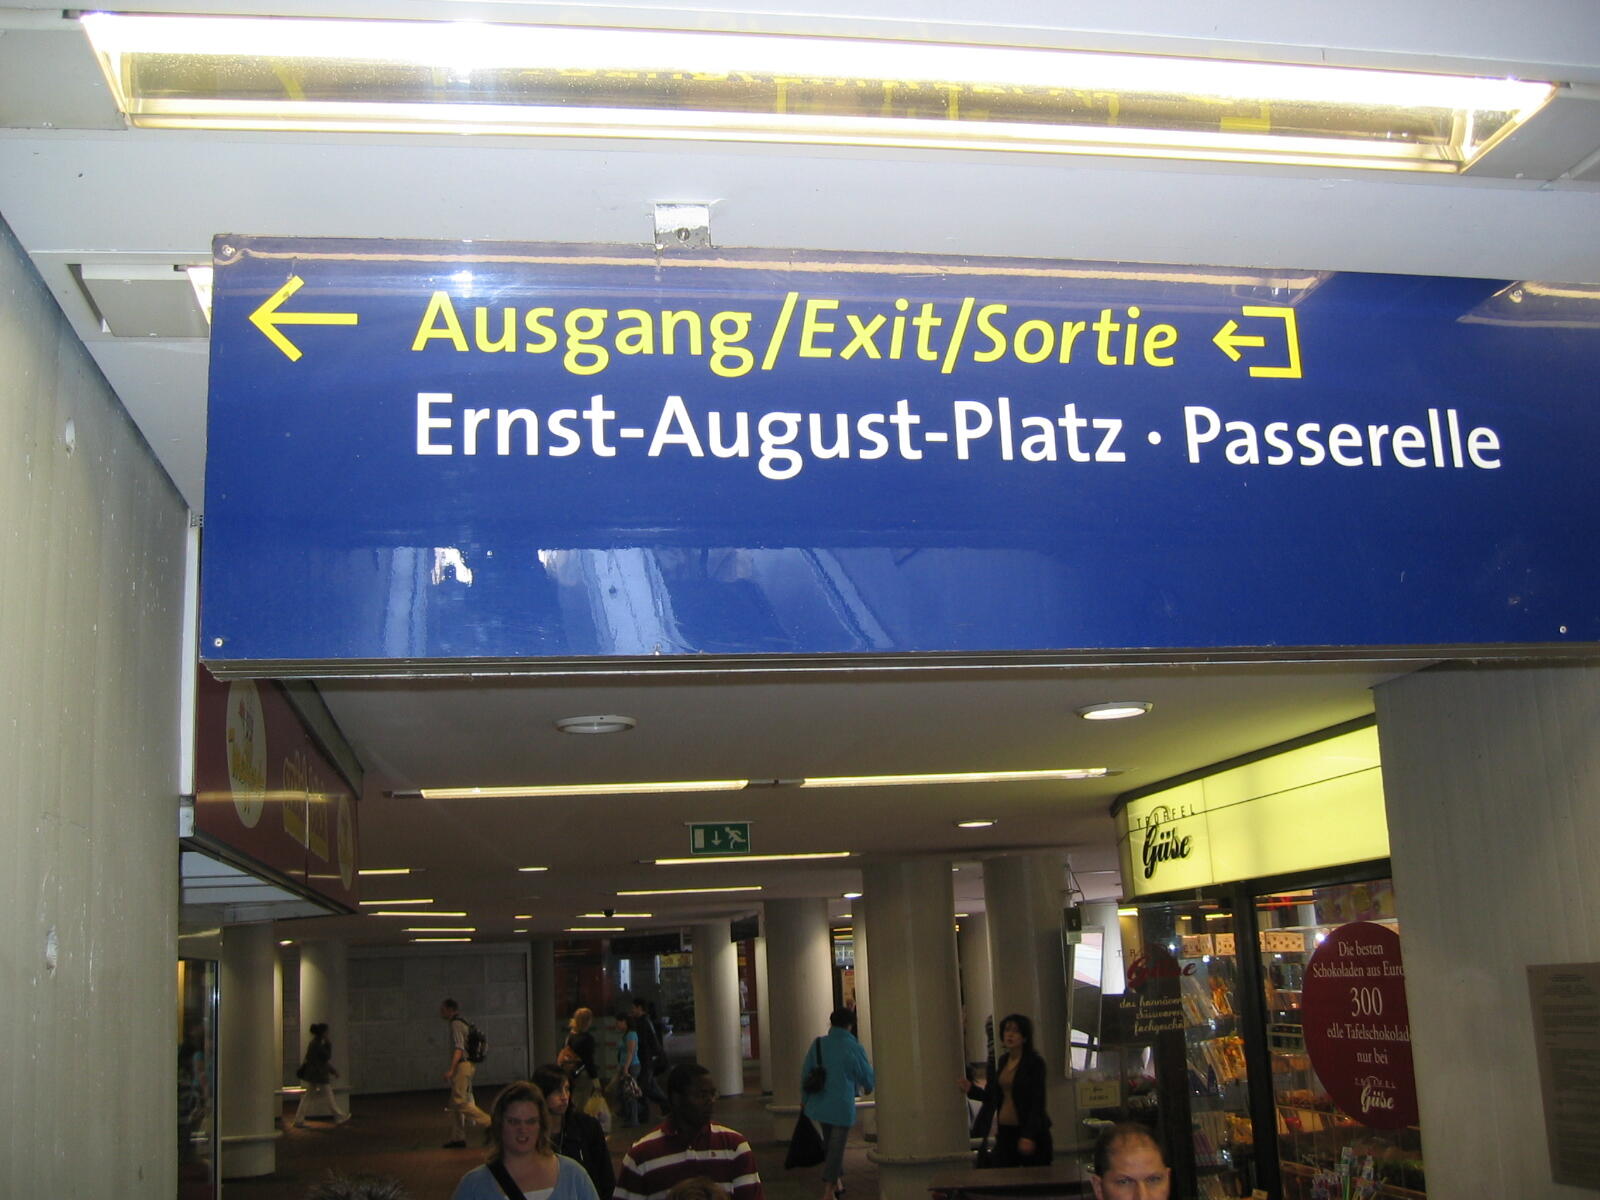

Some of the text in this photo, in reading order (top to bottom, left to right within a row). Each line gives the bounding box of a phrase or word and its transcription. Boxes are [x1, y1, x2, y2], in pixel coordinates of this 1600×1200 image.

[415, 391, 1502, 480] Ernst-August-Platz Passerelle
[1338, 940, 1384, 957] Die besten
[1312, 961, 1365, 978] Schokoladen
[1366, 965, 1381, 977] aus
[1350, 986, 1383, 1017] 300
[1327, 1022, 1344, 1039] edle
[1356, 1047, 1388, 1065] nur bei
